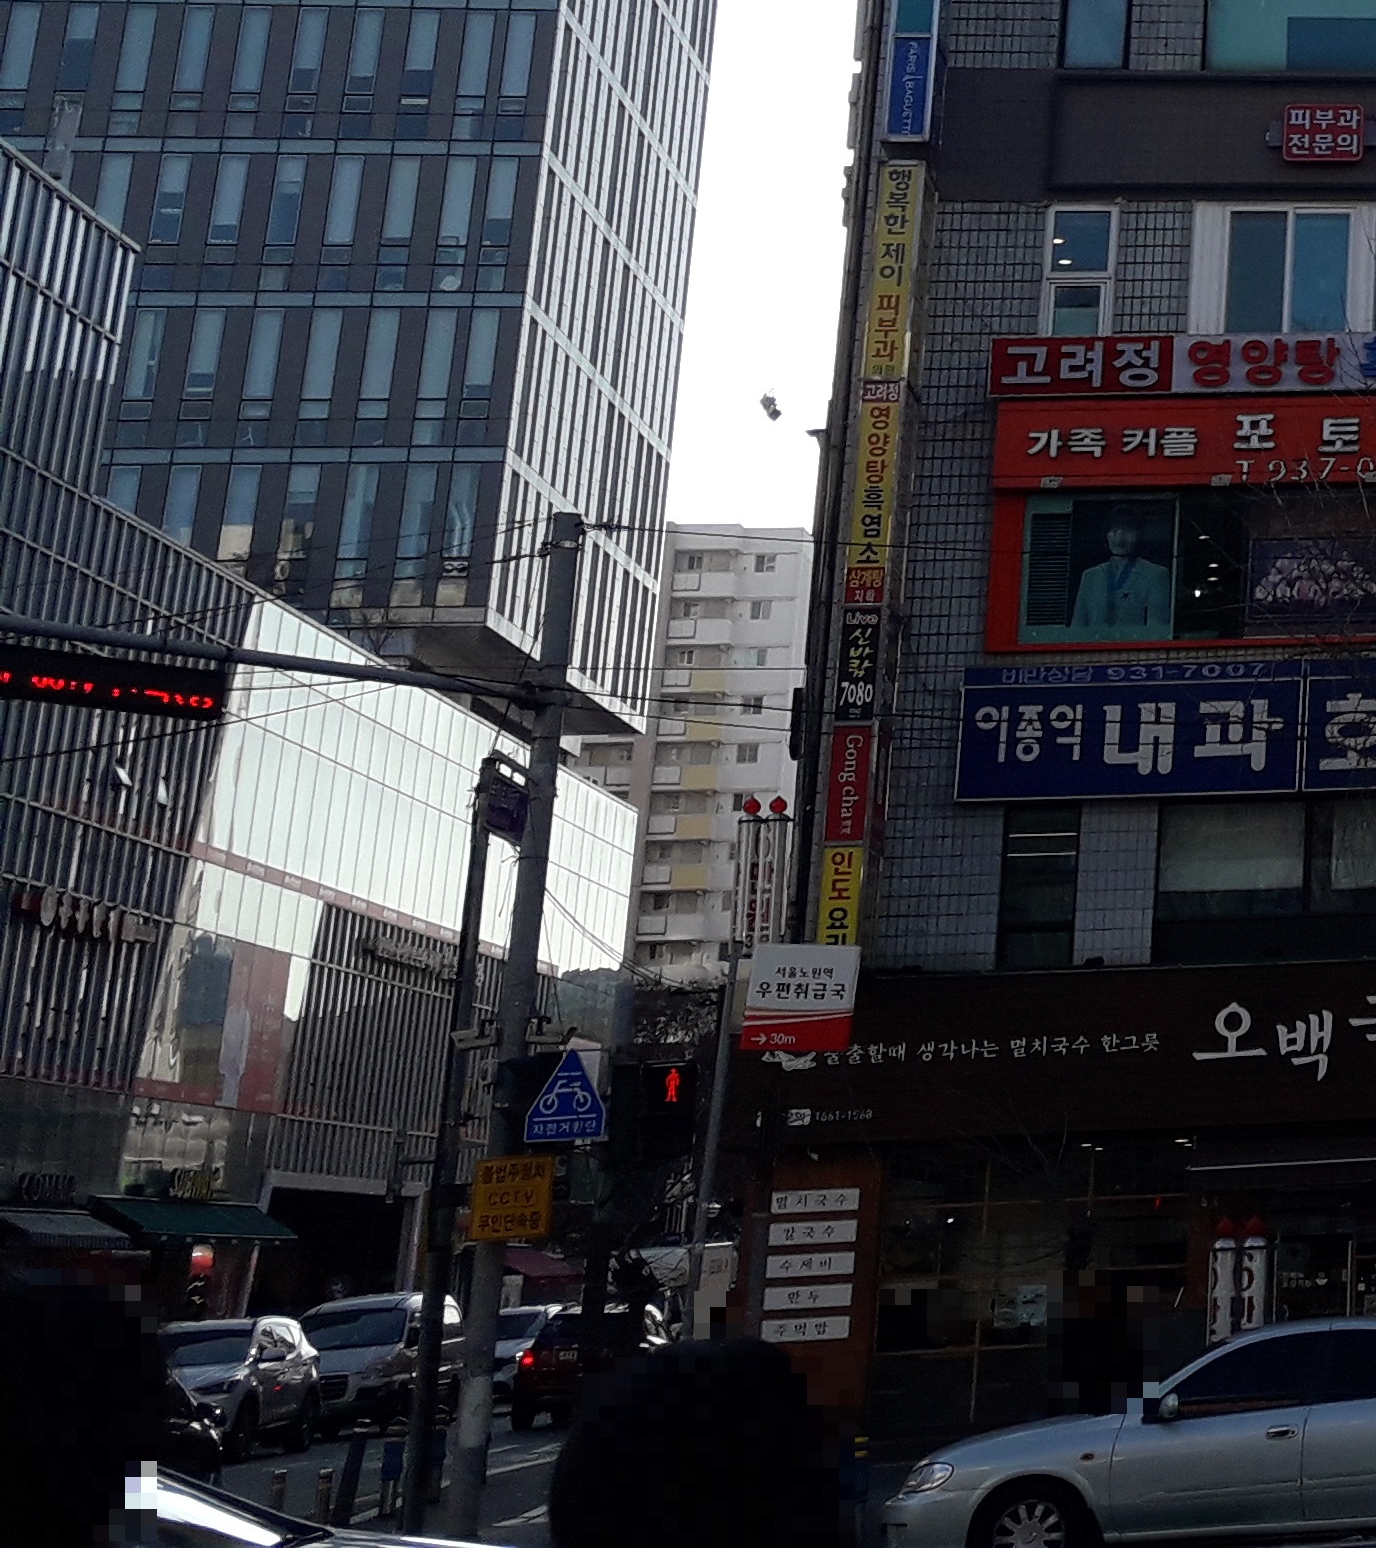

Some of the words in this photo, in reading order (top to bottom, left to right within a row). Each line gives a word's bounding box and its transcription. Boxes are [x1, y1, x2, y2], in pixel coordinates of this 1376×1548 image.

[1289, 107, 1362, 131] 피부과
[1287, 131, 1362, 158] 전문의
[883, 168, 913, 236] 행복한
[878, 241, 906, 288] 제이
[871, 293, 901, 363] 피부과
[999, 338, 1170, 392] 고려정
[1187, 336, 1339, 388] 영양탕
[1026, 425, 1108, 460] 가족
[1120, 423, 1200, 457] 커플
[1106, 660, 1267, 682] 931-7007
[839, 680, 874, 707] 7080
[974, 703, 1084, 764] 이종익
[1102, 697, 1286, 777] 내과
[840, 732, 866, 786] Gong
[755, 981, 848, 1002] 우편취급국
[769, 1032, 797, 1046] 30m
[916, 1038, 1001, 1065] 생각나는
[1009, 1032, 1092, 1060] 멸치국수
[1100, 1029, 1161, 1056] 한그릇
[488, 1188, 535, 1207] CCTV
